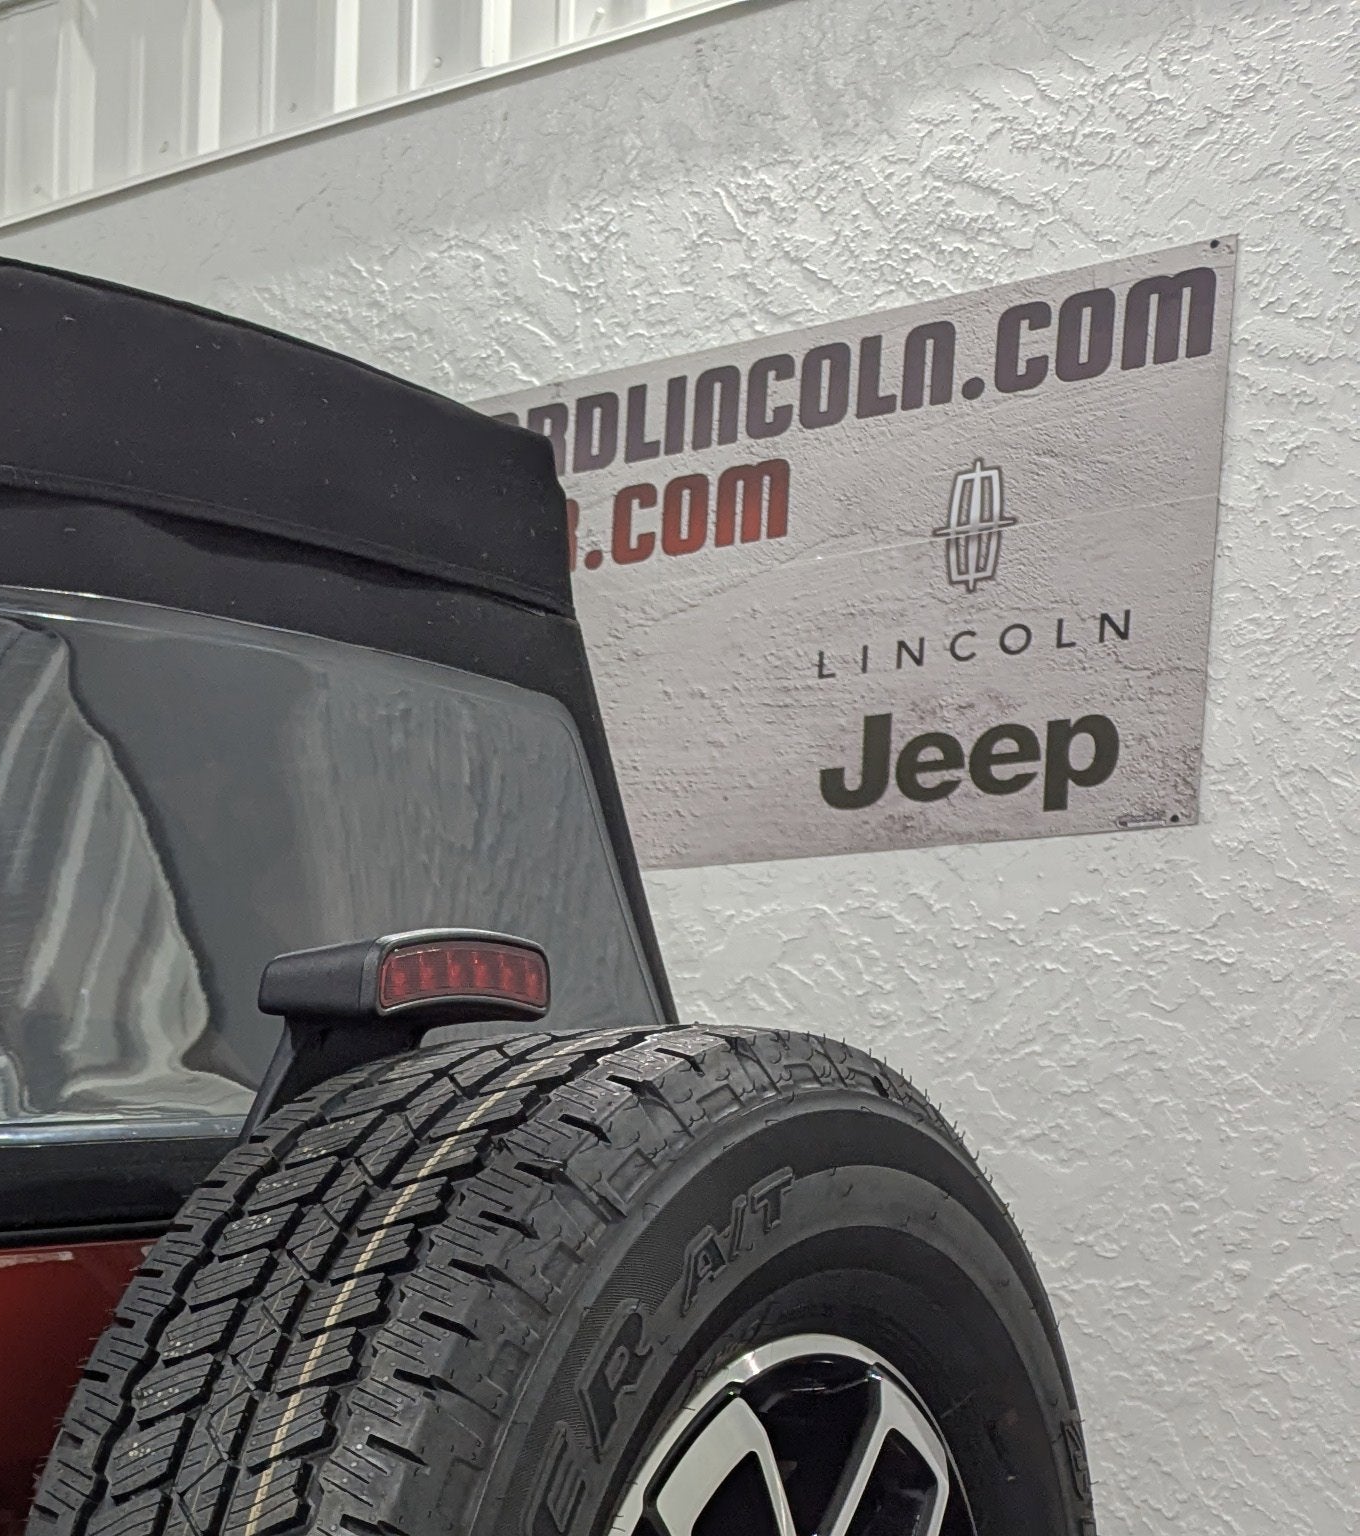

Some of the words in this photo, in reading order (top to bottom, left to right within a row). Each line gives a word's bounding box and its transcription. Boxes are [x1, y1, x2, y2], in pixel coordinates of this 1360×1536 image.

[491, 265, 1218, 476] RDLINCOLN.COM
[816, 608, 1132, 680] LINCOLN
[818, 711, 1120, 813] Jeep
